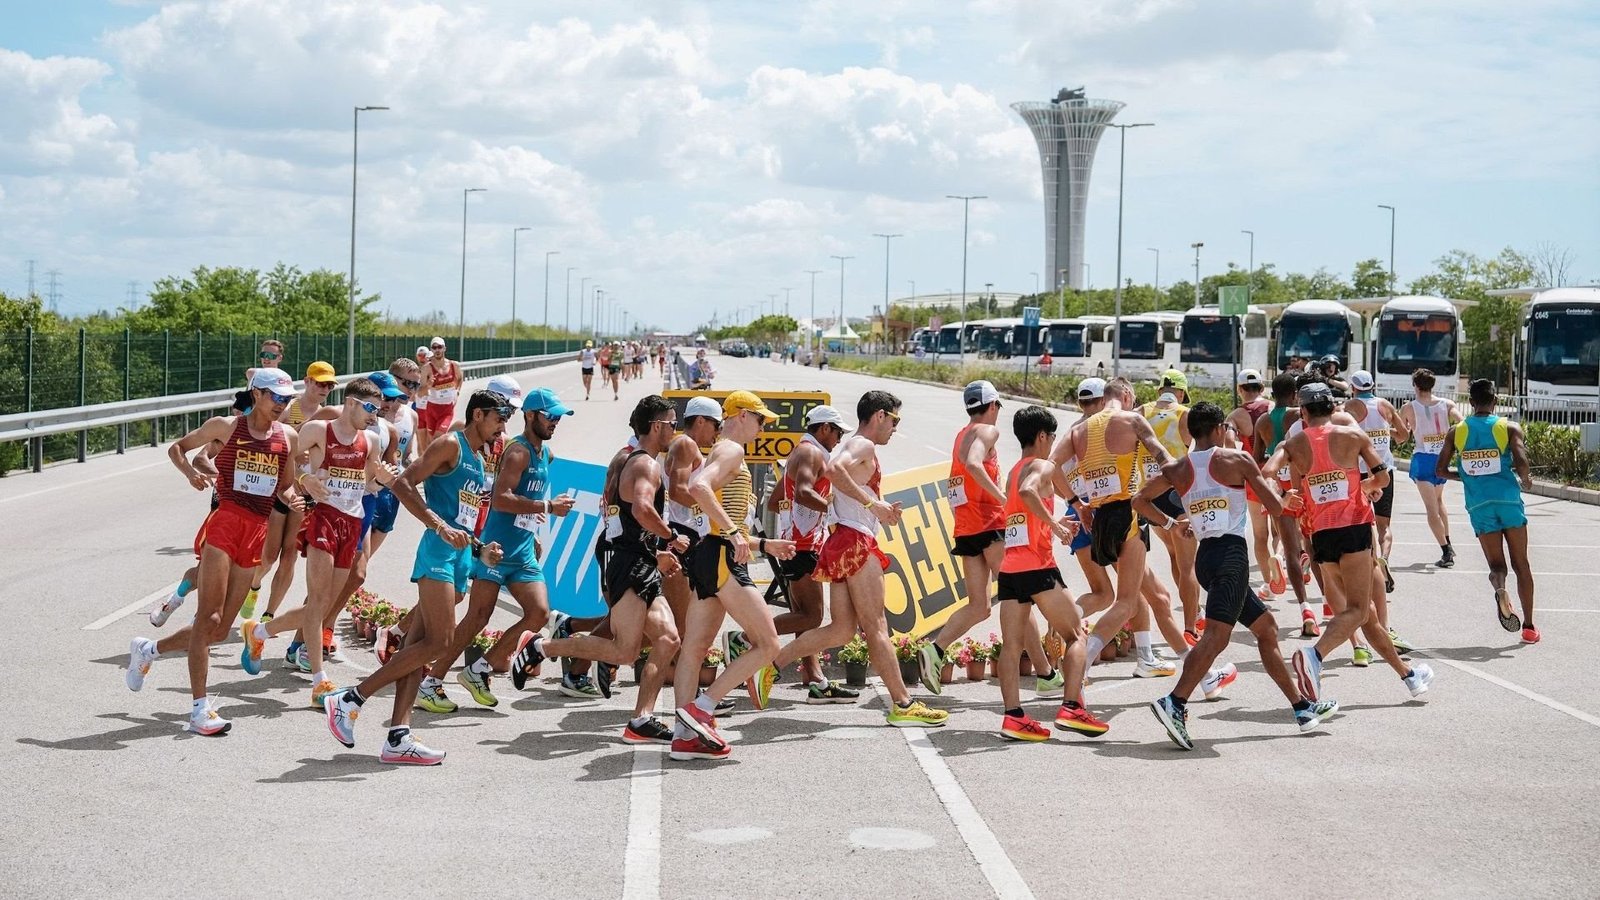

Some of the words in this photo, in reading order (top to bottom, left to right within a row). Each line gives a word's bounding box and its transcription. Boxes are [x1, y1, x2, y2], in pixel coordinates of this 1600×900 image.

[236, 449, 279, 465] CHINA
[1462, 450, 1498, 459] SEIKO
[237, 461, 278, 475] SEIKO
[1470, 460, 1490, 469] 209
[245, 473, 259, 484] CUI
[1085, 465, 1117, 480] SEIKO
[1307, 471, 1346, 486] SEIKO
[327, 480, 336, 488] A.
[1094, 477, 1109, 490] 192
[1319, 482, 1339, 495] 235
